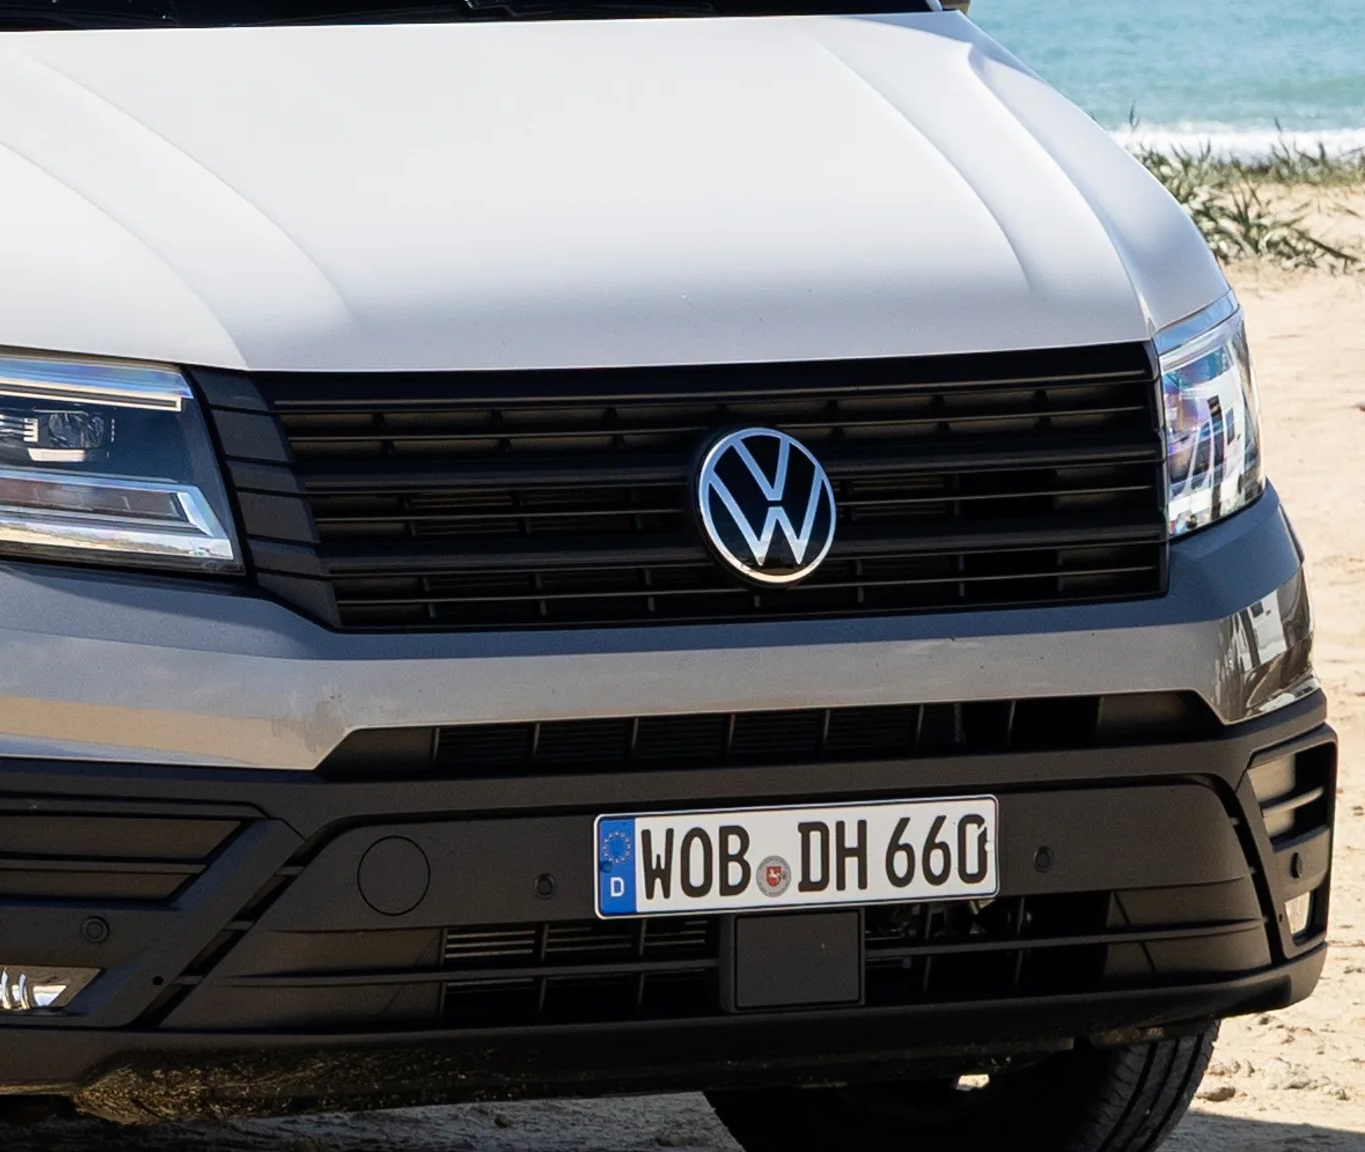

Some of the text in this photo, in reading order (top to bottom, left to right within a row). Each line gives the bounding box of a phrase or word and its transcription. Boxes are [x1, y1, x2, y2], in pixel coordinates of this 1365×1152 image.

[703, 430, 831, 572] VW
[610, 877, 625, 897] D
[641, 814, 988, 900] WOB DH 660
